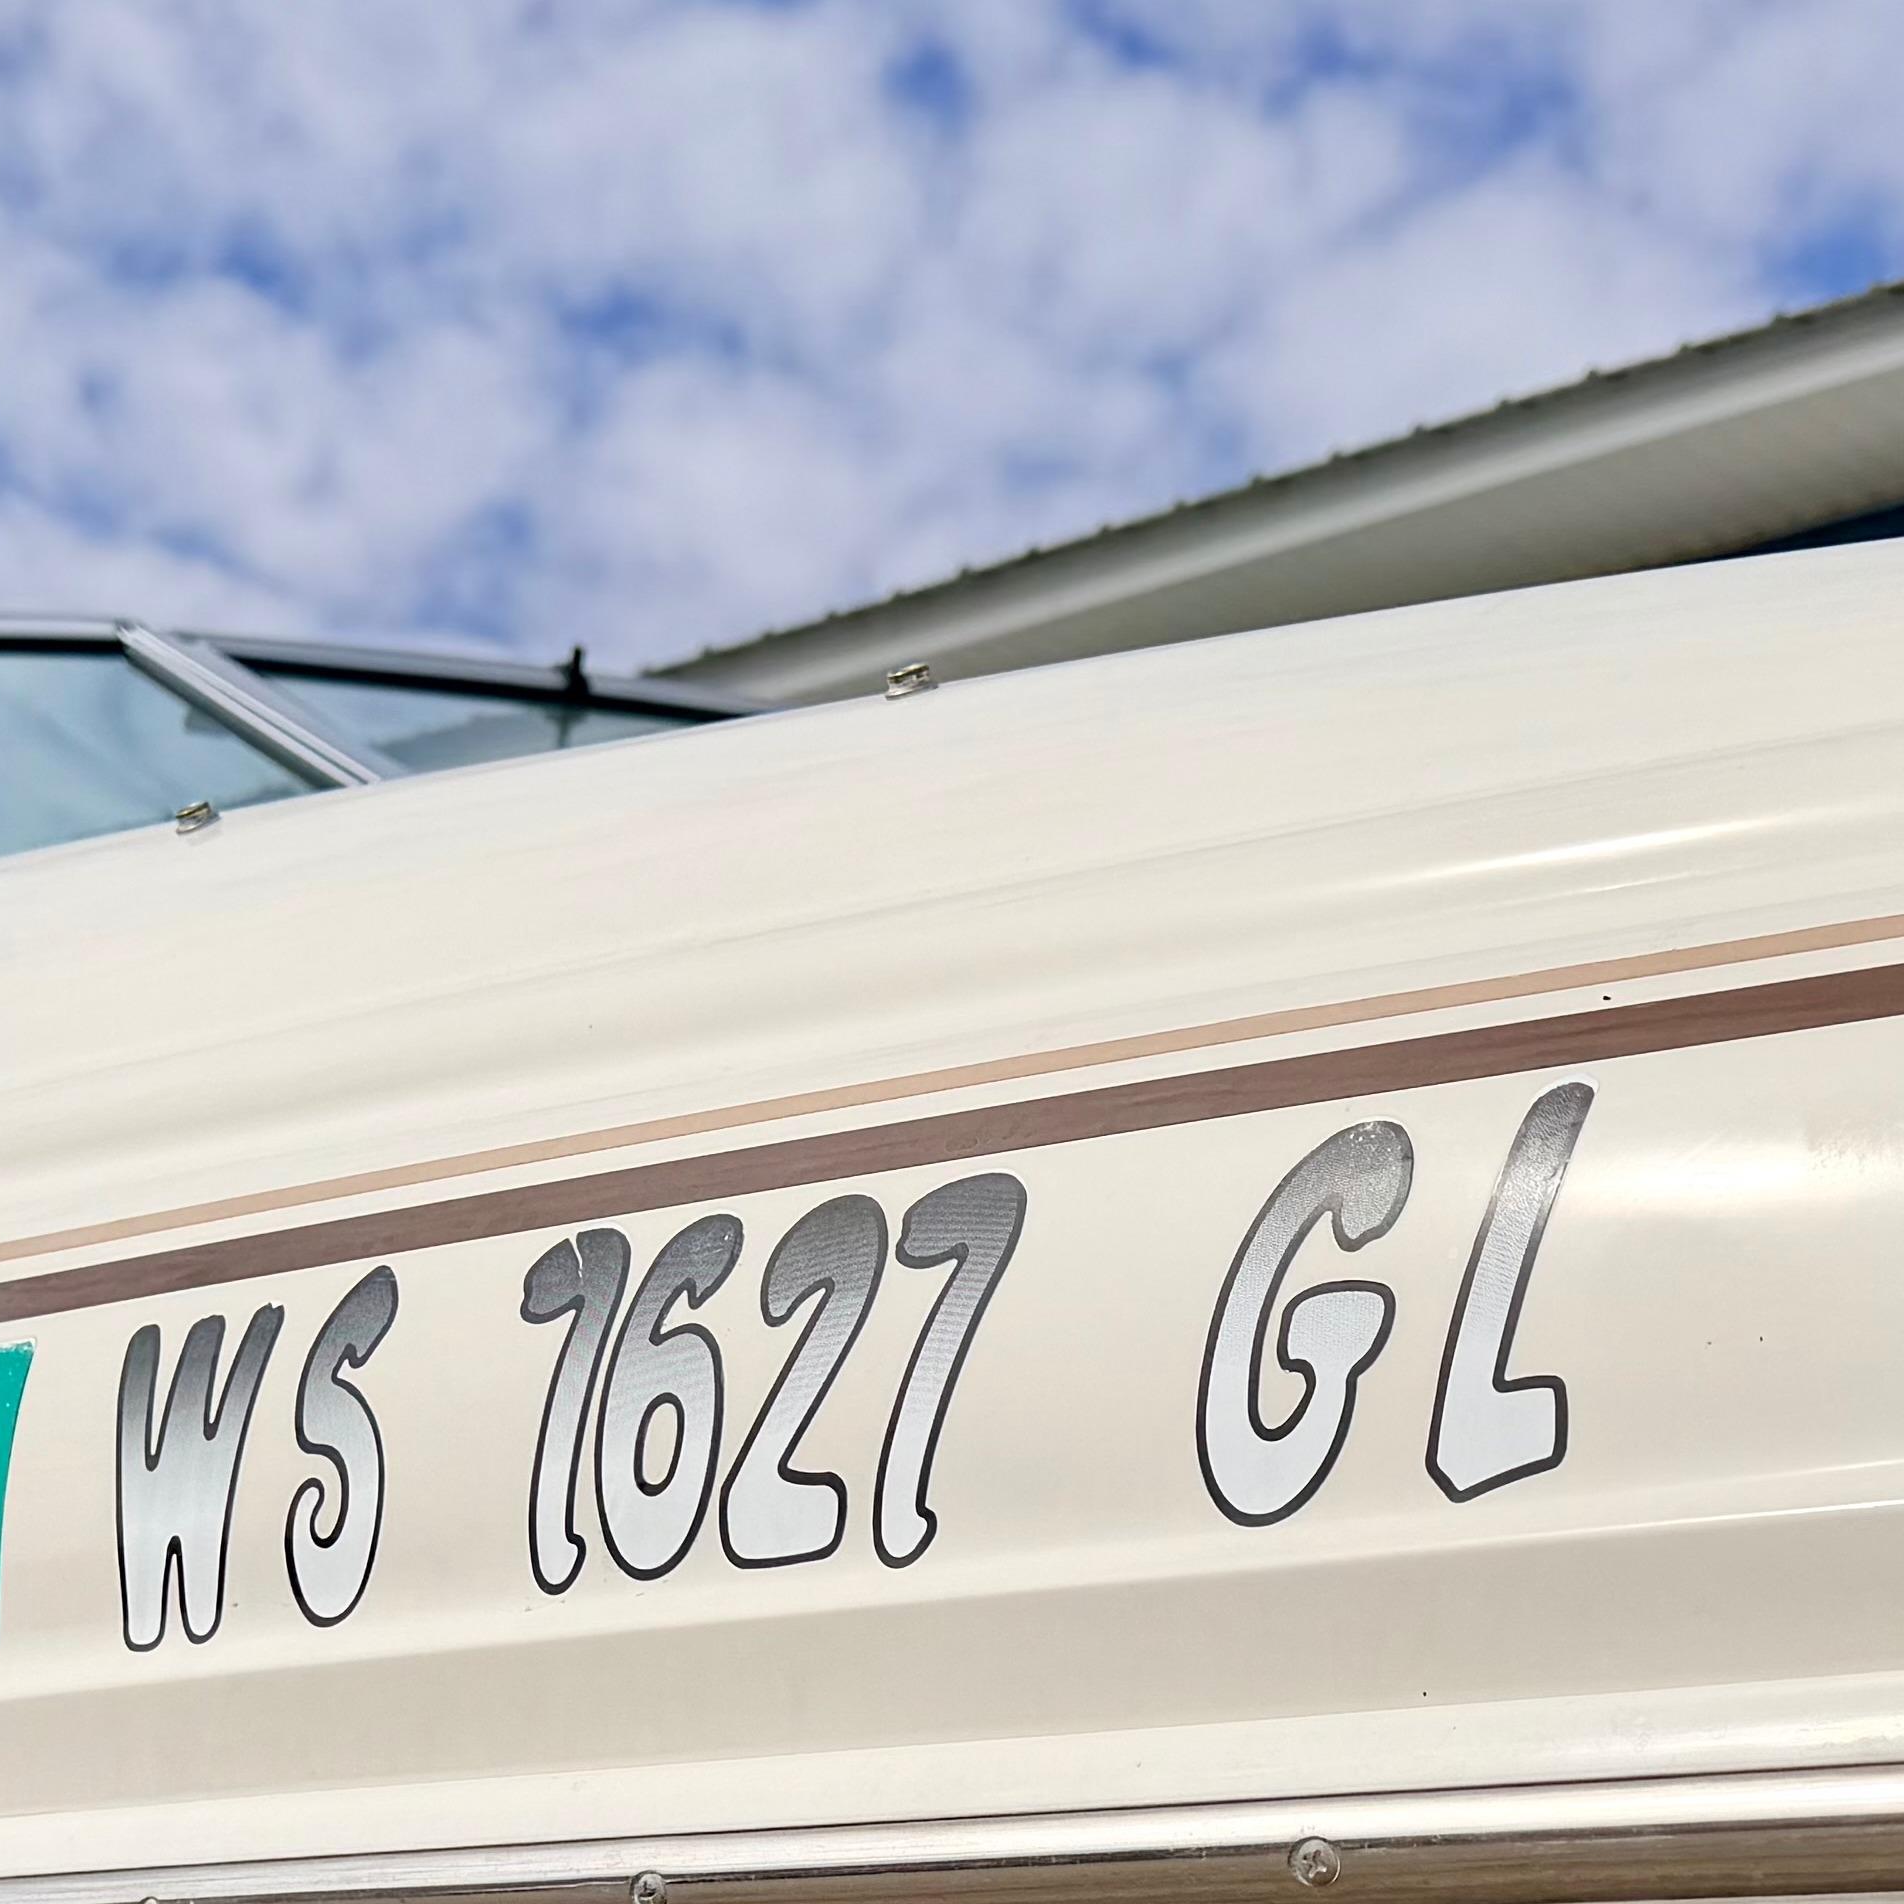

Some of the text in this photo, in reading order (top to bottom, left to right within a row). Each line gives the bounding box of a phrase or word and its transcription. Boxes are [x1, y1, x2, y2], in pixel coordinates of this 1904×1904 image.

[116, 1078, 1596, 1652] WS 7627 GL
